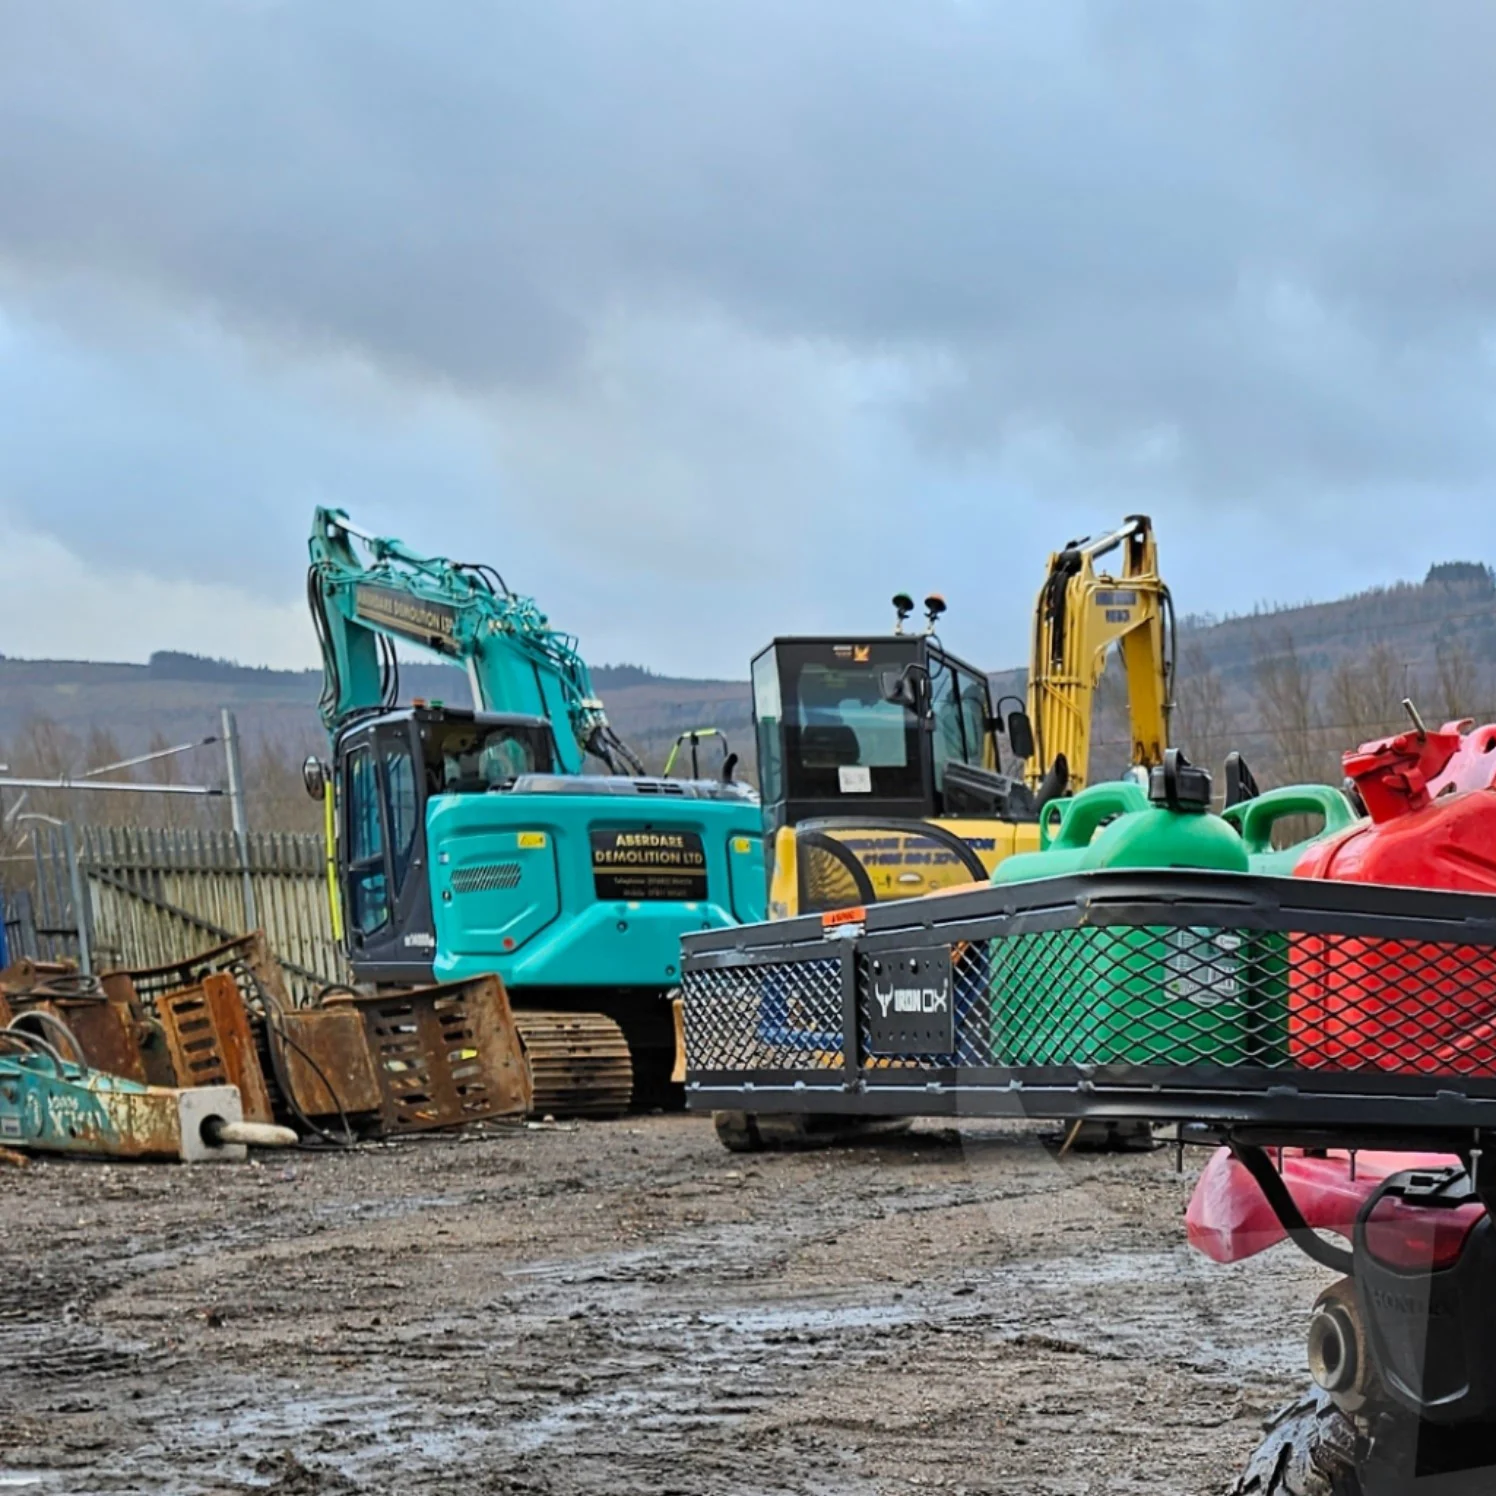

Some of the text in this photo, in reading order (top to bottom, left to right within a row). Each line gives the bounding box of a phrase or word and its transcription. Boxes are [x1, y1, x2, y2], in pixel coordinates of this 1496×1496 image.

[615, 833, 685, 848] ABERDARE
[595, 849, 704, 865] DEMOLITION LTD
[894, 988, 921, 1012] IRON
